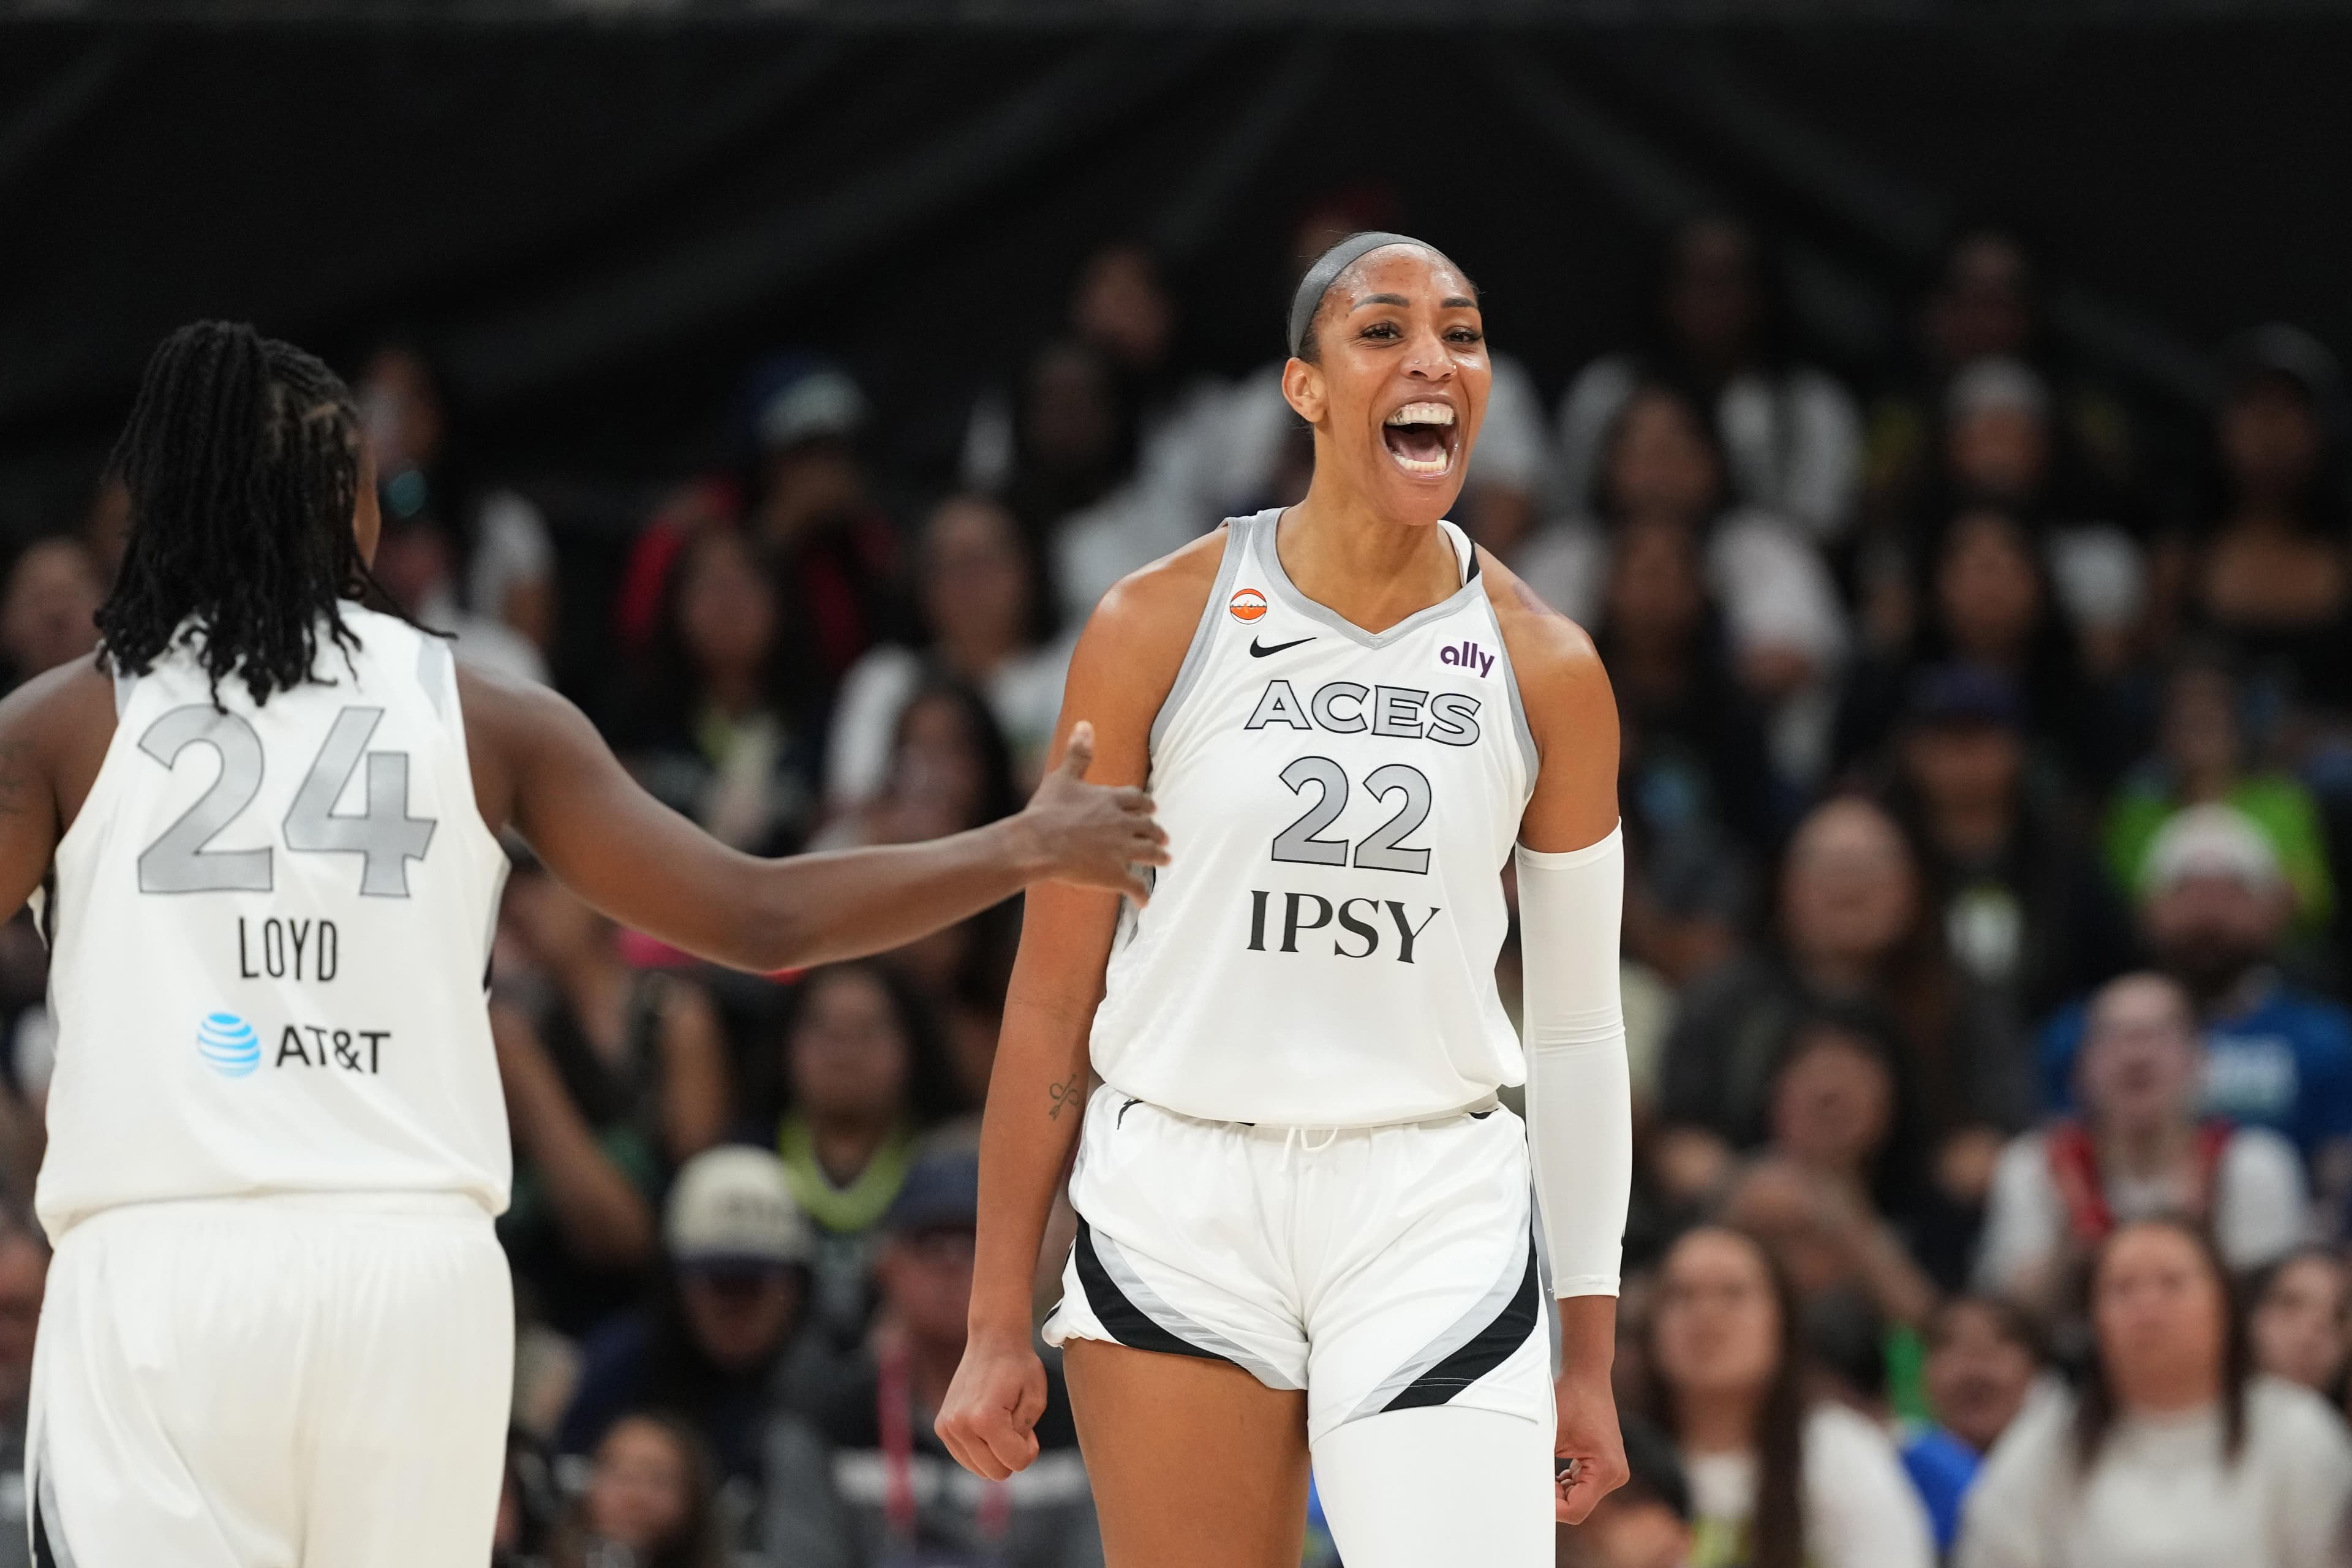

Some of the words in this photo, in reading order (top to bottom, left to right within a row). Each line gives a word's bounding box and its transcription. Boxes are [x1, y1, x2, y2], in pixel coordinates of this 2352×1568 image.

[1440, 641, 1494, 678] ally
[1244, 679, 1482, 747] ACES
[137, 703, 438, 899] 24
[1271, 756, 1433, 875] 22
[238, 917, 337, 982] LOYD
[1246, 890, 1441, 964] IPSY
[276, 1025, 391, 1074] AT&T
